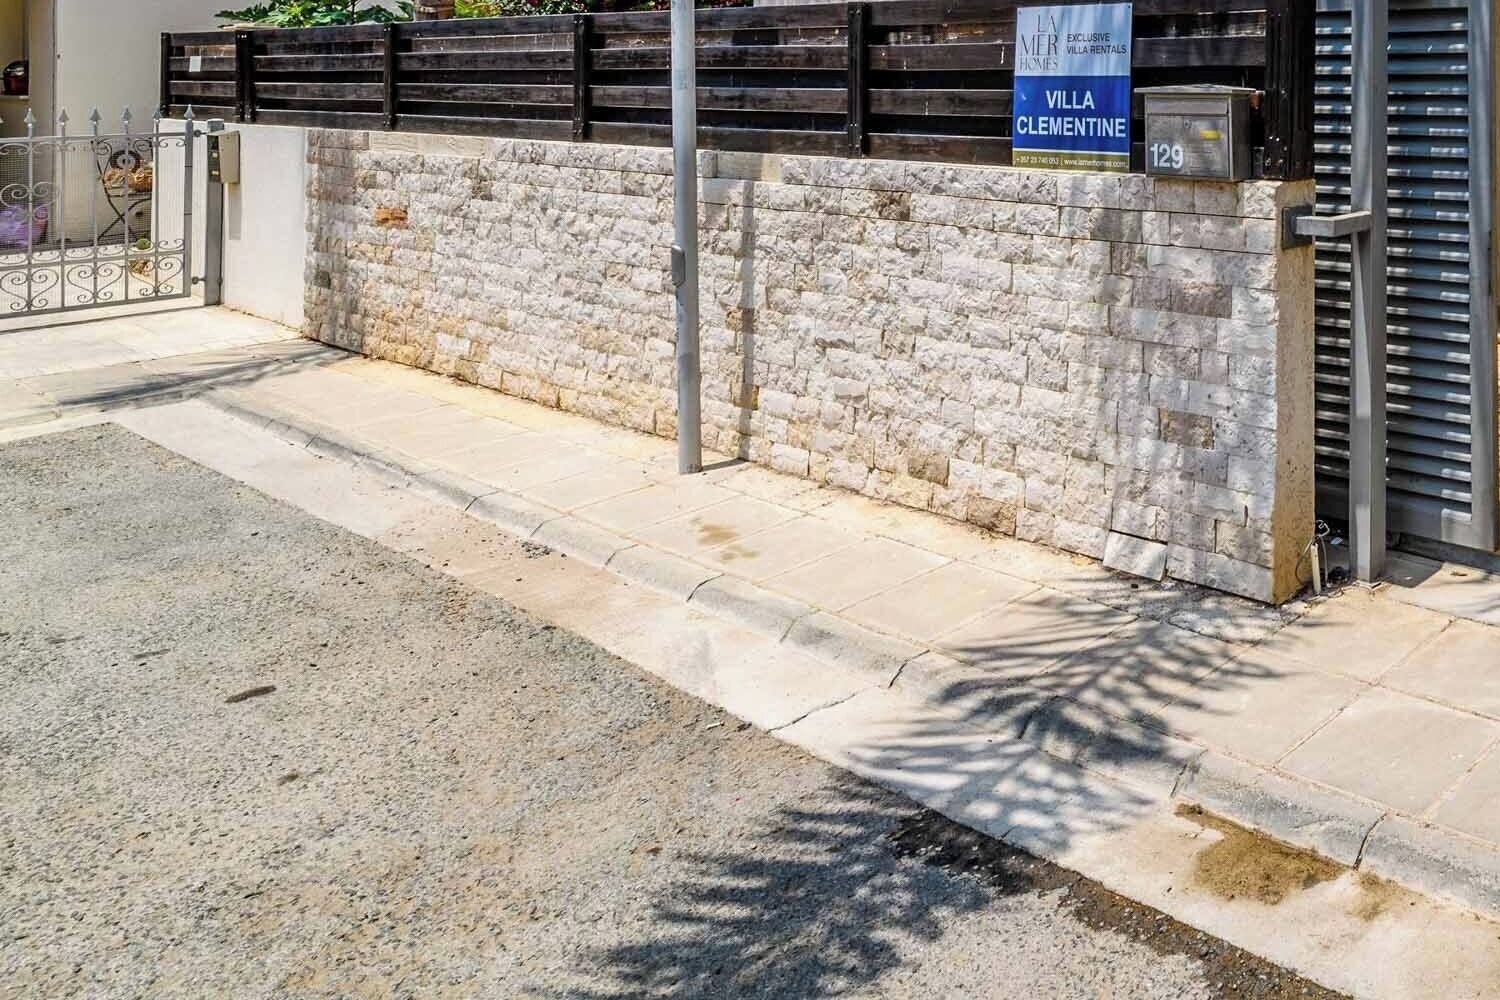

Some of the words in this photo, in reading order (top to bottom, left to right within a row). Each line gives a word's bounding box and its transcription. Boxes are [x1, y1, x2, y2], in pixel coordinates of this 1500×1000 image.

[1037, 15, 1057, 33] LA
[1020, 33, 1058, 56] MER
[1066, 33, 1111, 43] EXCLUSIVE
[1066, 45, 1089, 55] VILLA
[1090, 44, 1128, 55] RENTALS
[1019, 57, 1058, 71] HOMES
[1045, 89, 1096, 110] VILLA
[1016, 115, 1127, 138] CLEMENTINE
[1149, 143, 1184, 169] 129
